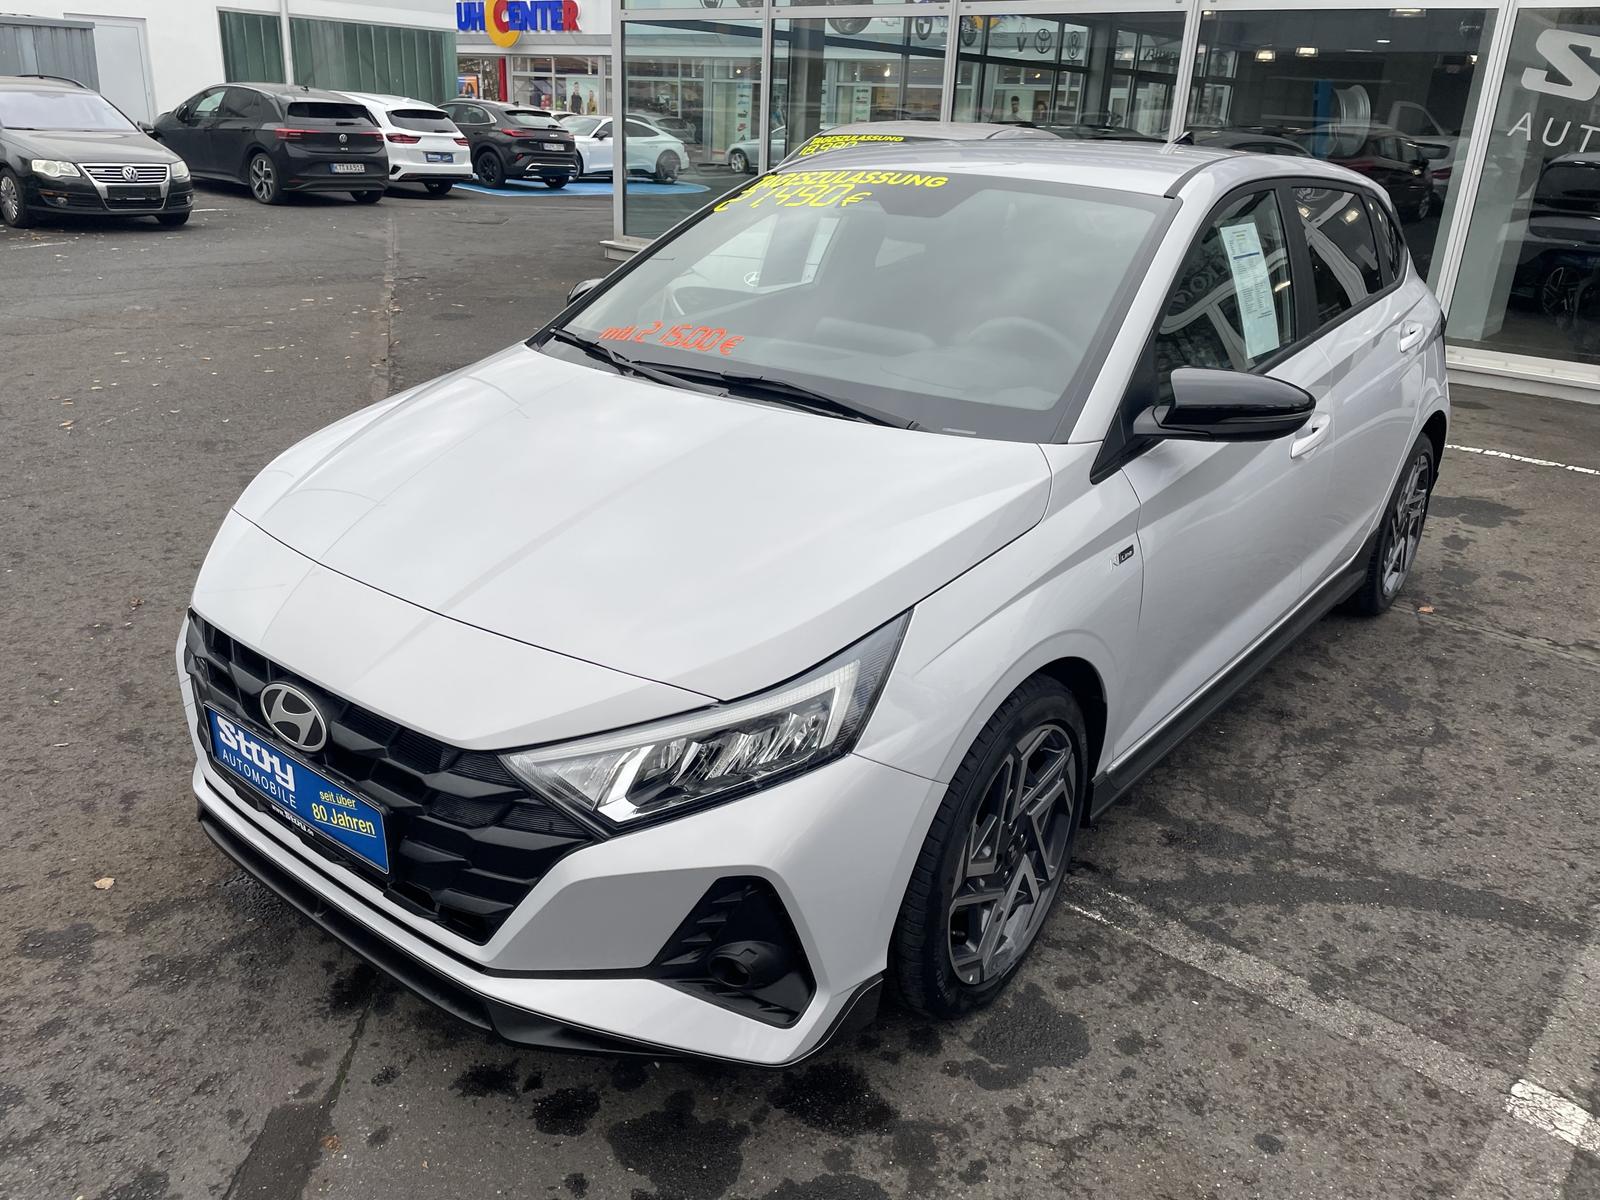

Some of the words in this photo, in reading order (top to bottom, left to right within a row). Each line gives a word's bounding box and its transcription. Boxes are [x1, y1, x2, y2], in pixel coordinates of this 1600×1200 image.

[810, 134, 905, 147] TAGESZULASSUNG
[1507, 112, 1600, 153] AUT
[757, 170, 949, 188] TAGESZULASSUNG
[222, 749, 297, 809] AUTOMOBILE
[320, 790, 334, 803] seit
[335, 793, 356, 808] über
[311, 803, 327, 821] 80
[330, 808, 375, 835] Jahren
